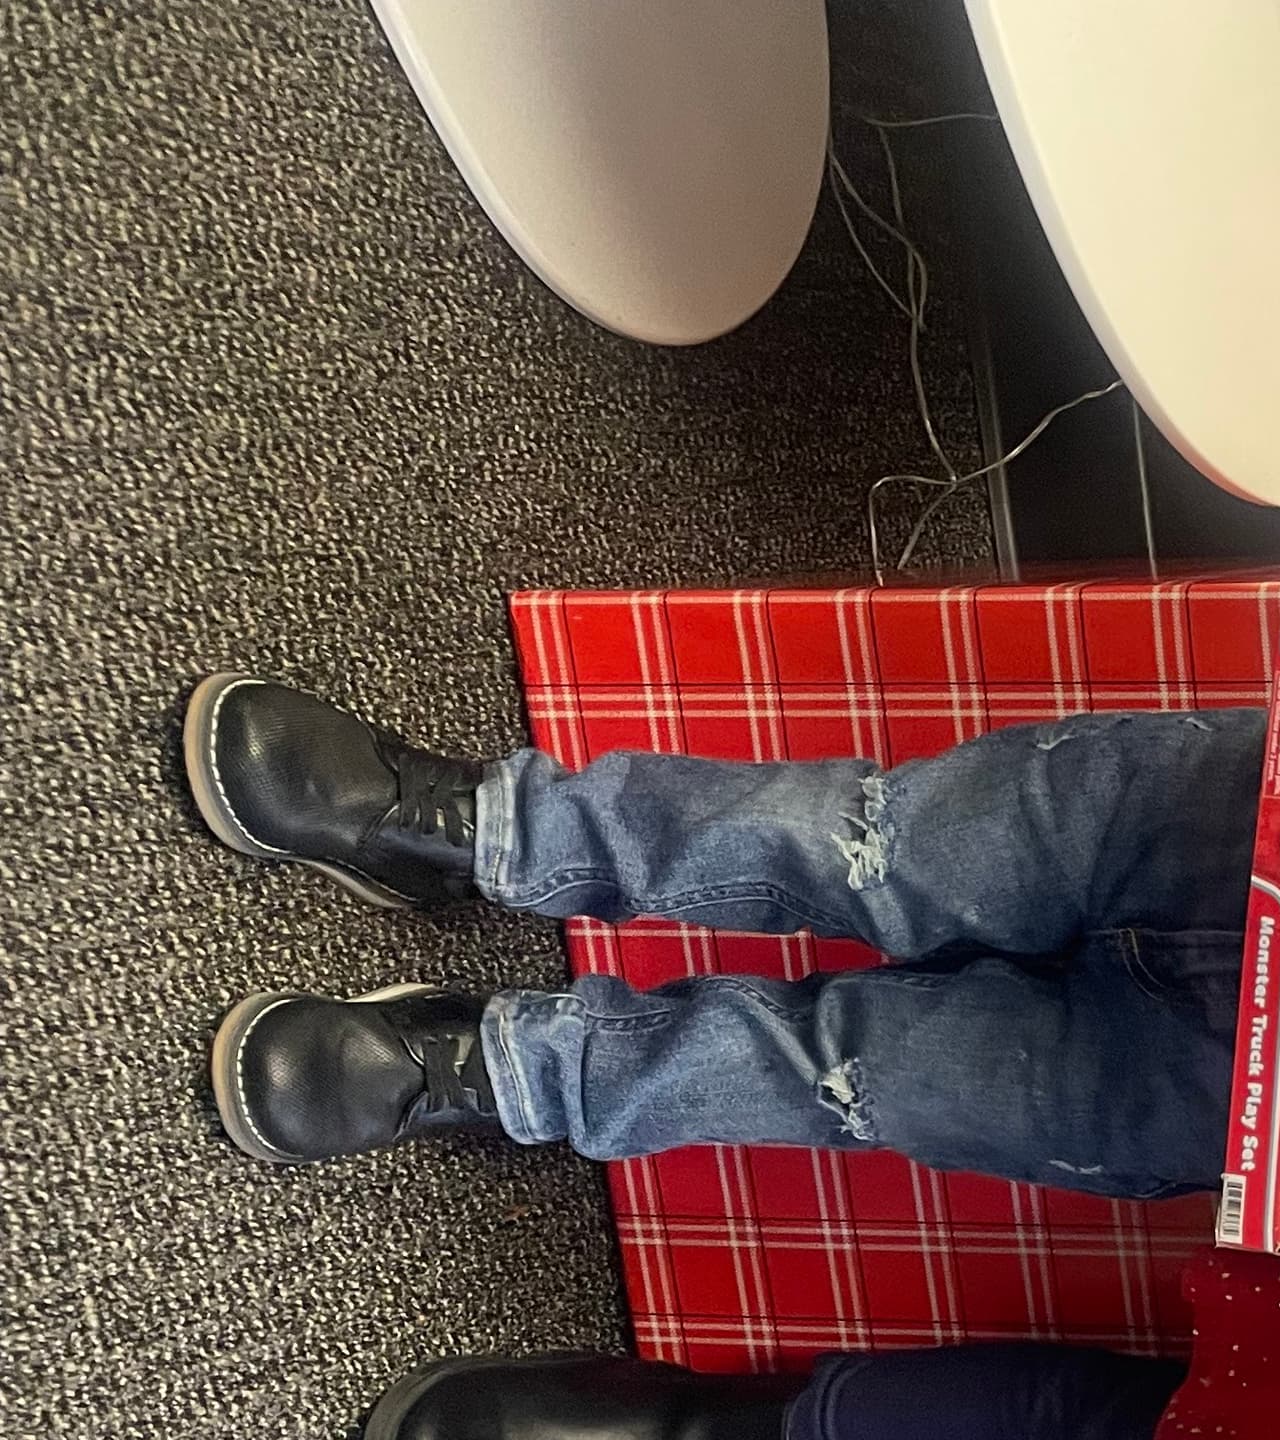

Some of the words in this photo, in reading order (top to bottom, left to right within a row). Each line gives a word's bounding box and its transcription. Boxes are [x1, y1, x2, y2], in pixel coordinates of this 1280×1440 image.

[1253, 916, 1275, 1008] Monster
[1248, 1014, 1269, 1076] Truck
[1240, 1082, 1263, 1129] Play
[1240, 1135, 1259, 1172] Set
